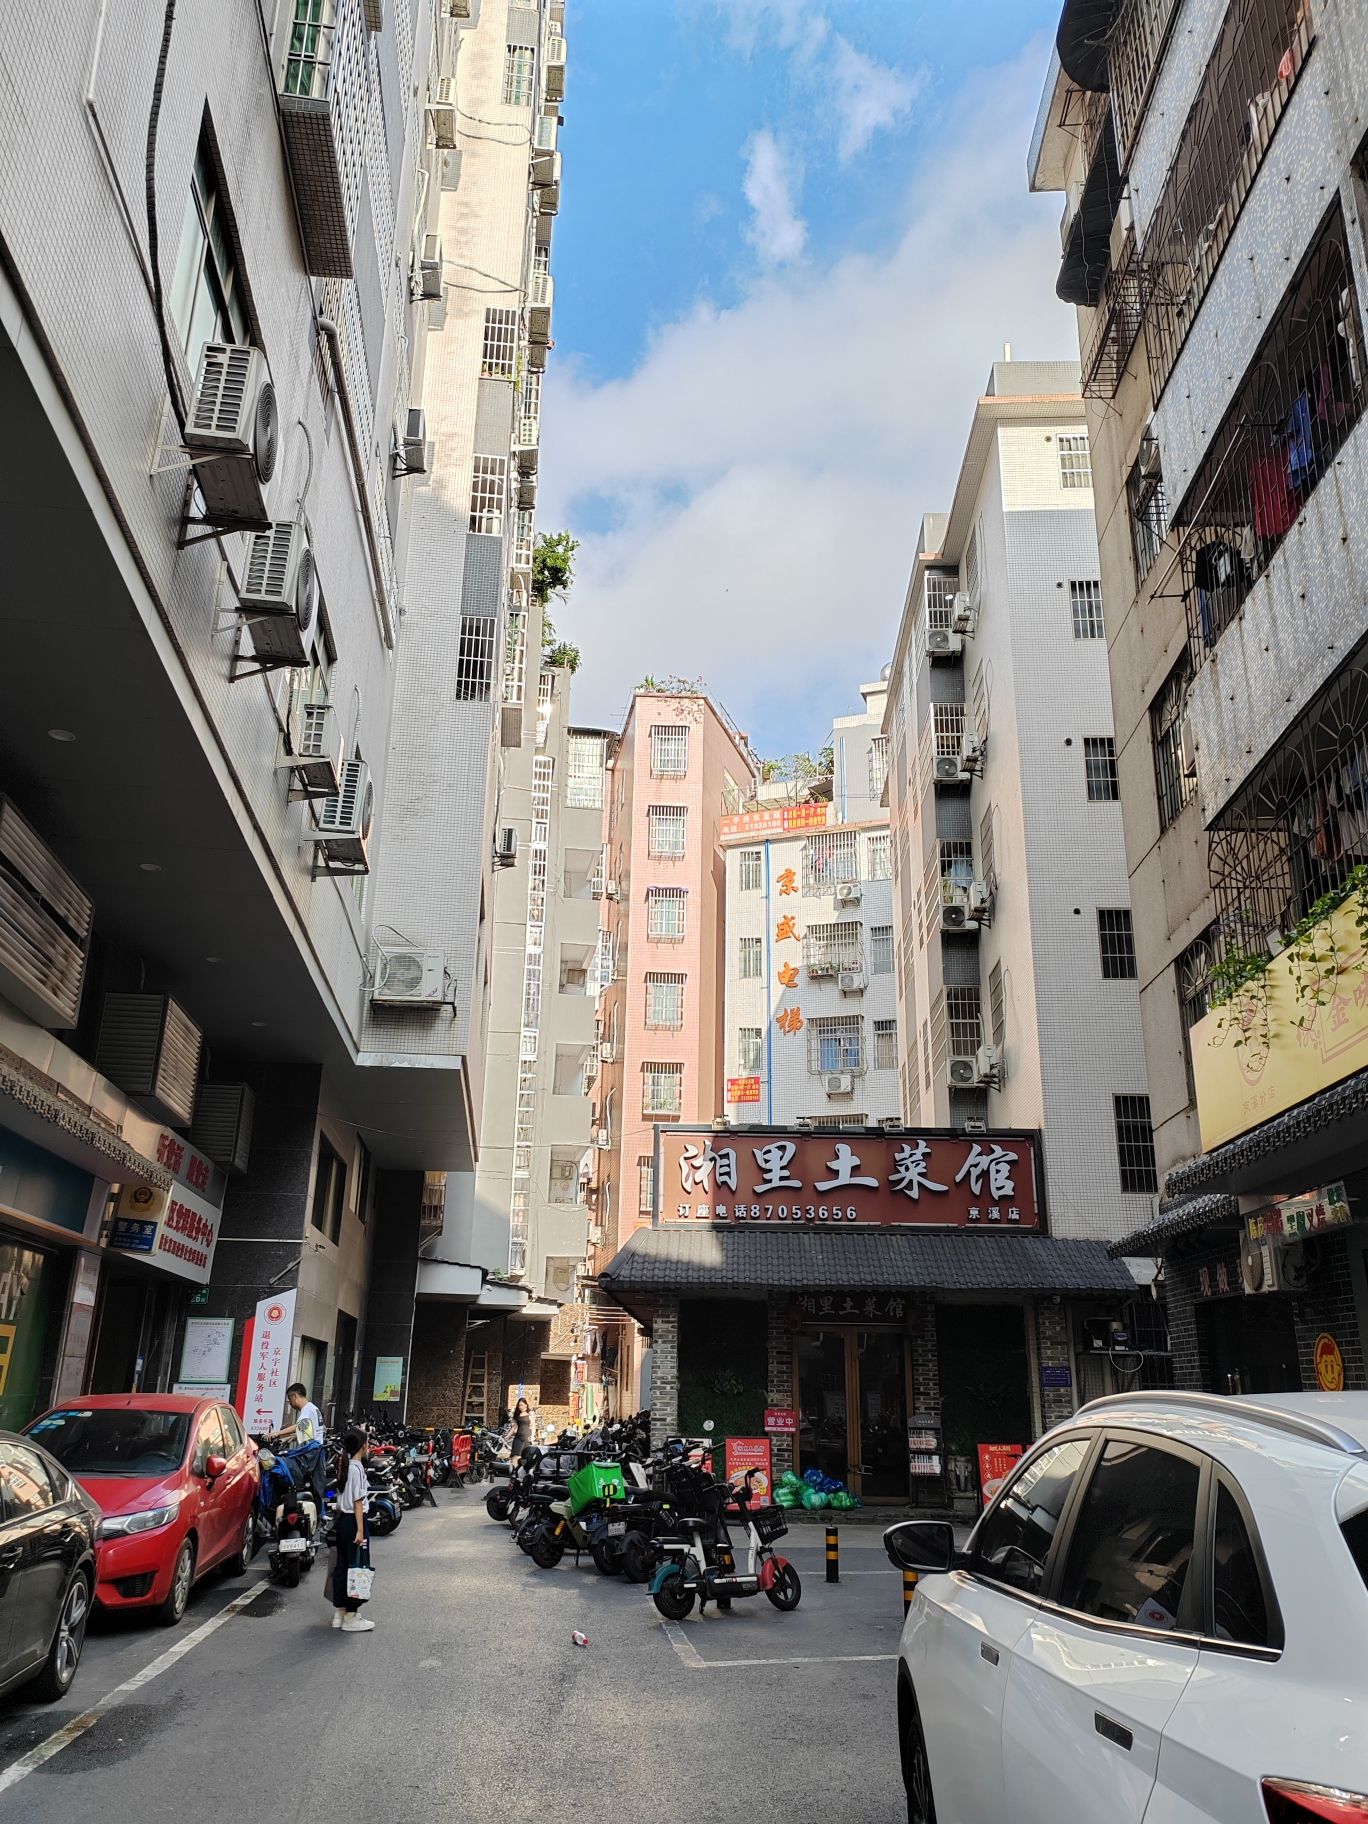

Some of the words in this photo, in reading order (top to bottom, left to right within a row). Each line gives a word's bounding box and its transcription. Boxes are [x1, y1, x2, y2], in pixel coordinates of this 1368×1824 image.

[775, 868, 804, 1036] 京盛电梯
[679, 1139, 1019, 1200] 湘里土菜馆
[968, 1206, 1020, 1220] 京溪店
[117, 1220, 155, 1235] 警务室
[797, 1295, 905, 1319] 湘里土菜馆
[254, 1330, 271, 1404] 退役军人服务站
[767, 1416, 794, 1427] 营业中
